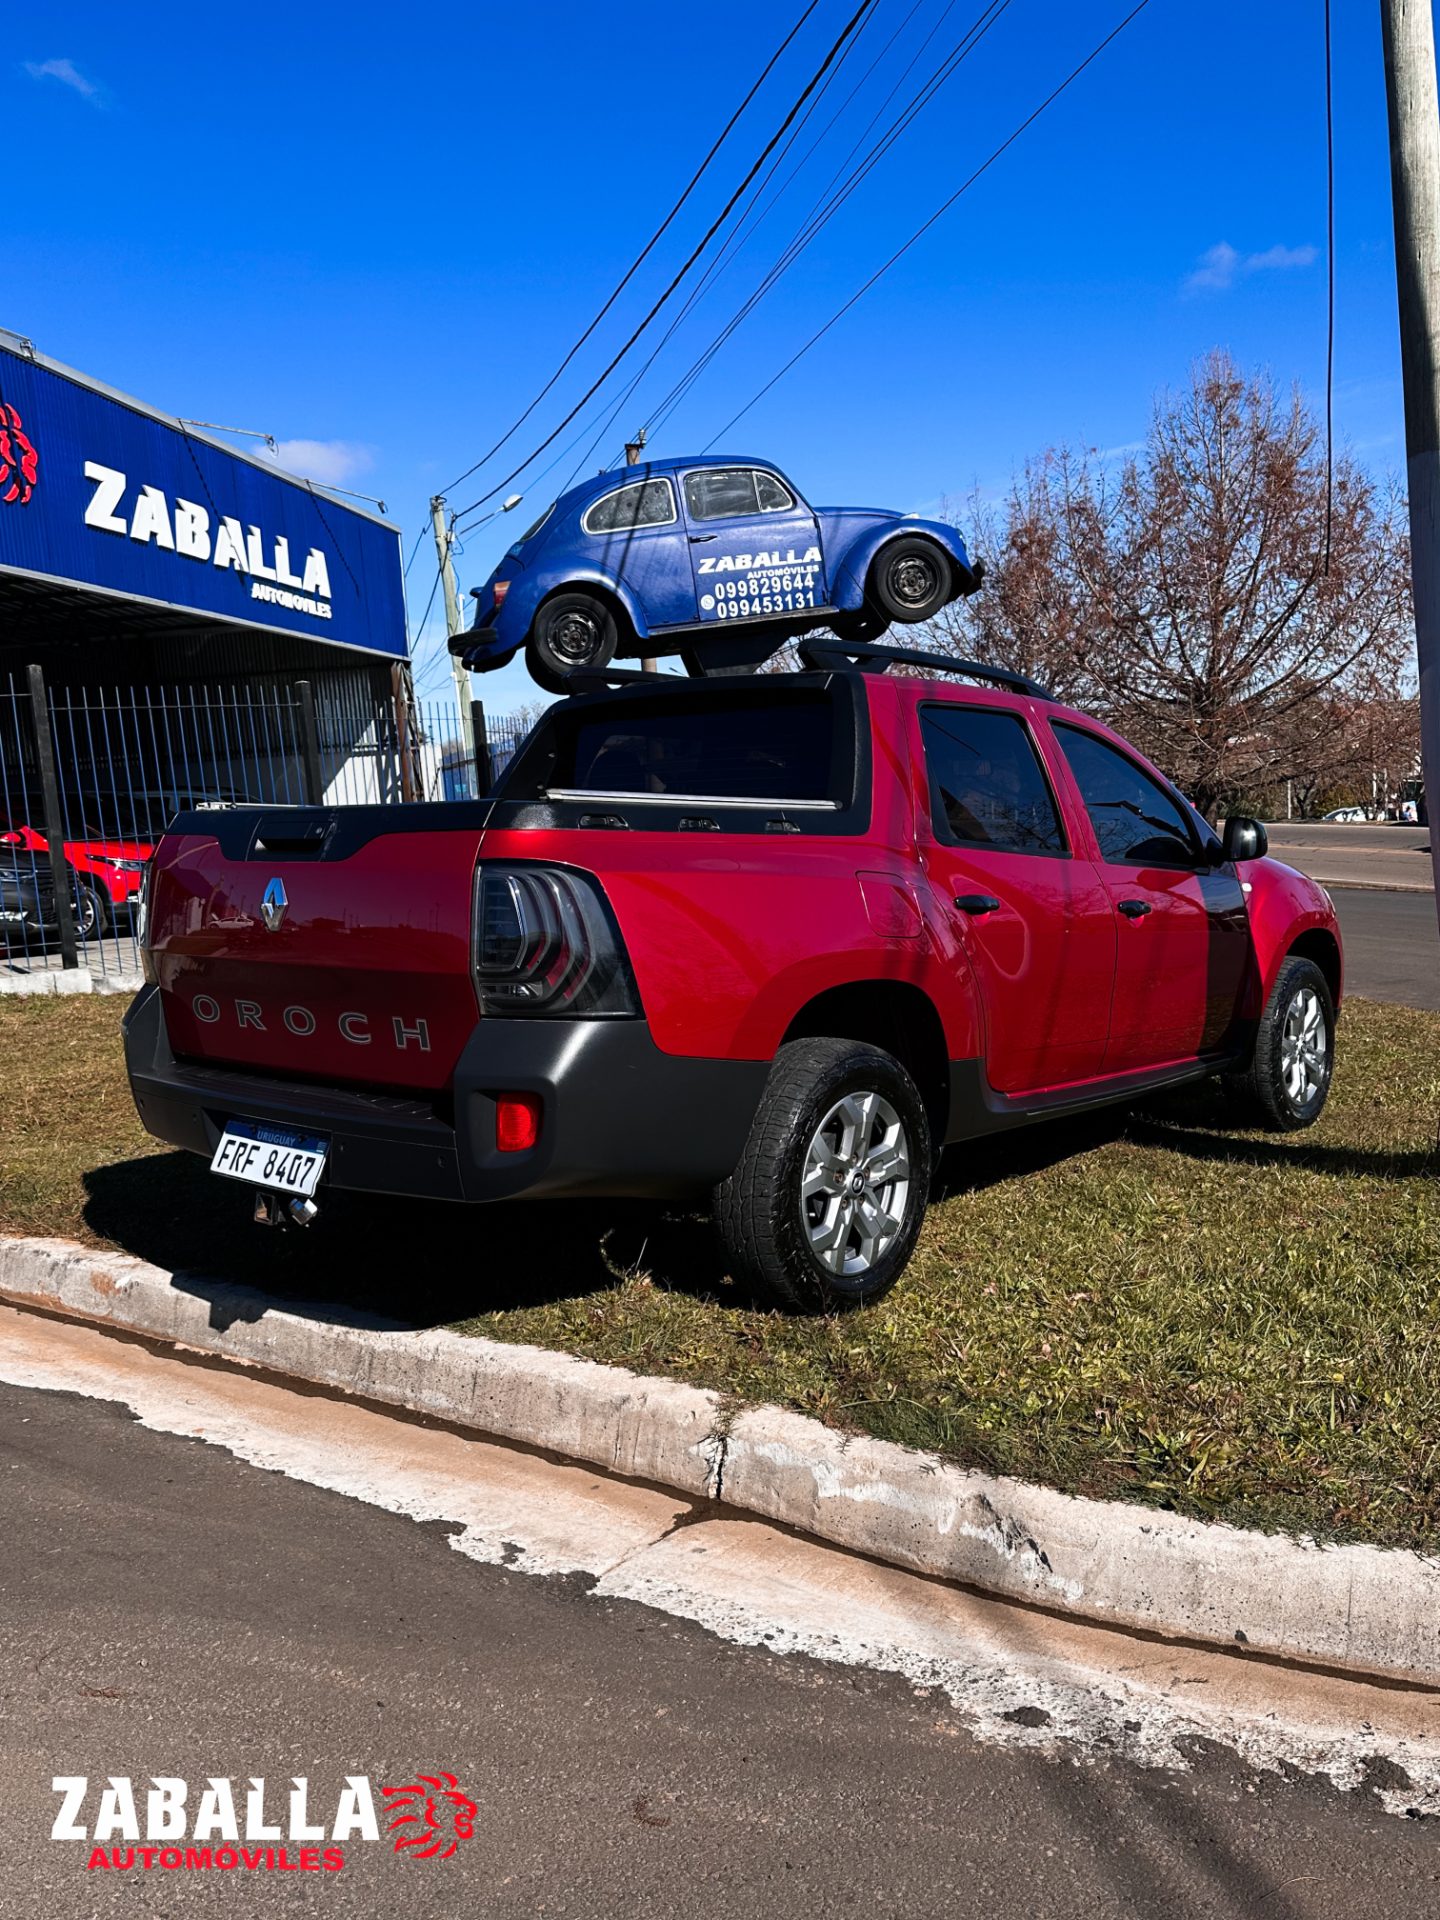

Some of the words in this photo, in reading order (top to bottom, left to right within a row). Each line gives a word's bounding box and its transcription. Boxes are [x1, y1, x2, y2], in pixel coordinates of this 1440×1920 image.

[84, 461, 332, 599] ZABALLA
[698, 547, 822, 574] ZABALLA
[714, 573, 815, 600] 099829644
[717, 591, 815, 619] 099453131
[192, 994, 432, 1051] OROCH
[256, 1130, 296, 1147] URUGUAY
[217, 1139, 261, 1173] FRF
[263, 1149, 316, 1188] 8407
